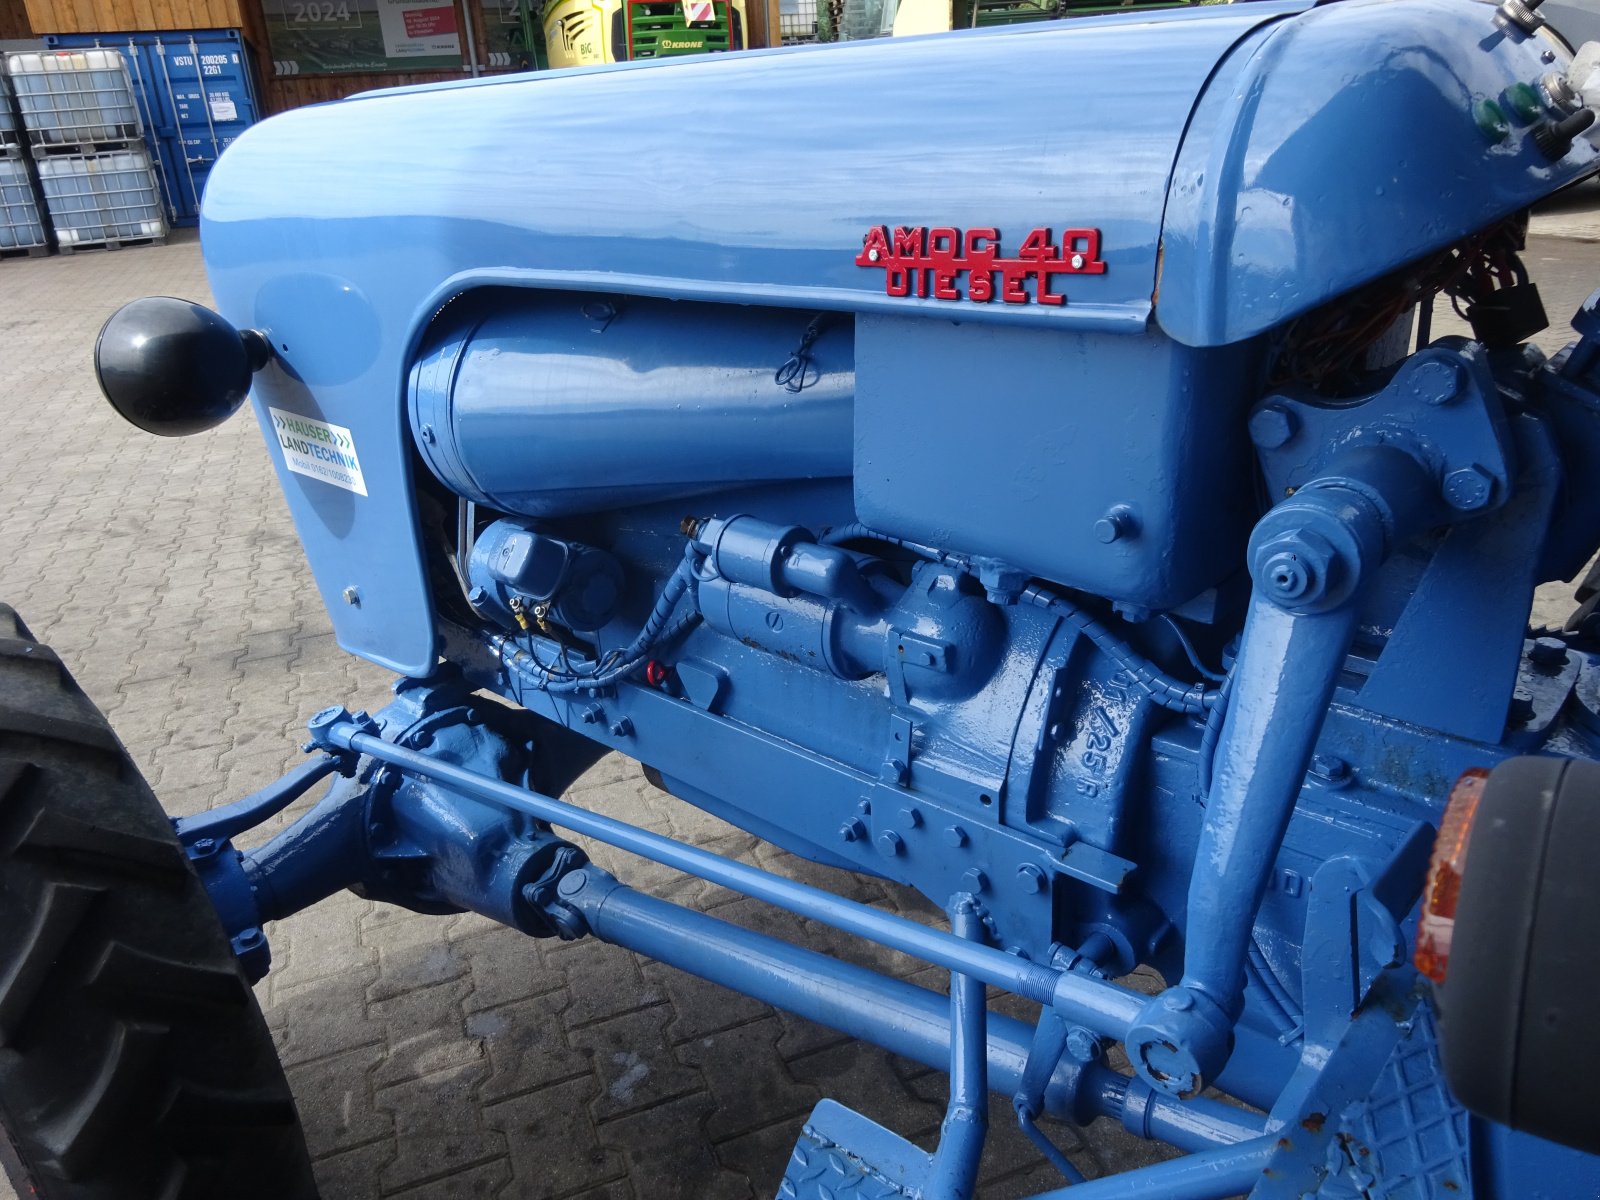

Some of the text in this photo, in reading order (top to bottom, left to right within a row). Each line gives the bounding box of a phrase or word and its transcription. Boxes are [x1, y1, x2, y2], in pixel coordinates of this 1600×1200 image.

[292, 1, 351, 22] 2024
[174, 56, 193, 66] VSTU
[200, 55, 228, 65] 200205
[580, 42, 592, 55] BiG
[203, 65, 222, 75] 22G1
[858, 224, 1100, 265] AMOG 40
[886, 267, 1067, 306] DIESEL
[286, 417, 332, 444] HAUSER
[280, 434, 359, 471] LANDTECHNIK
